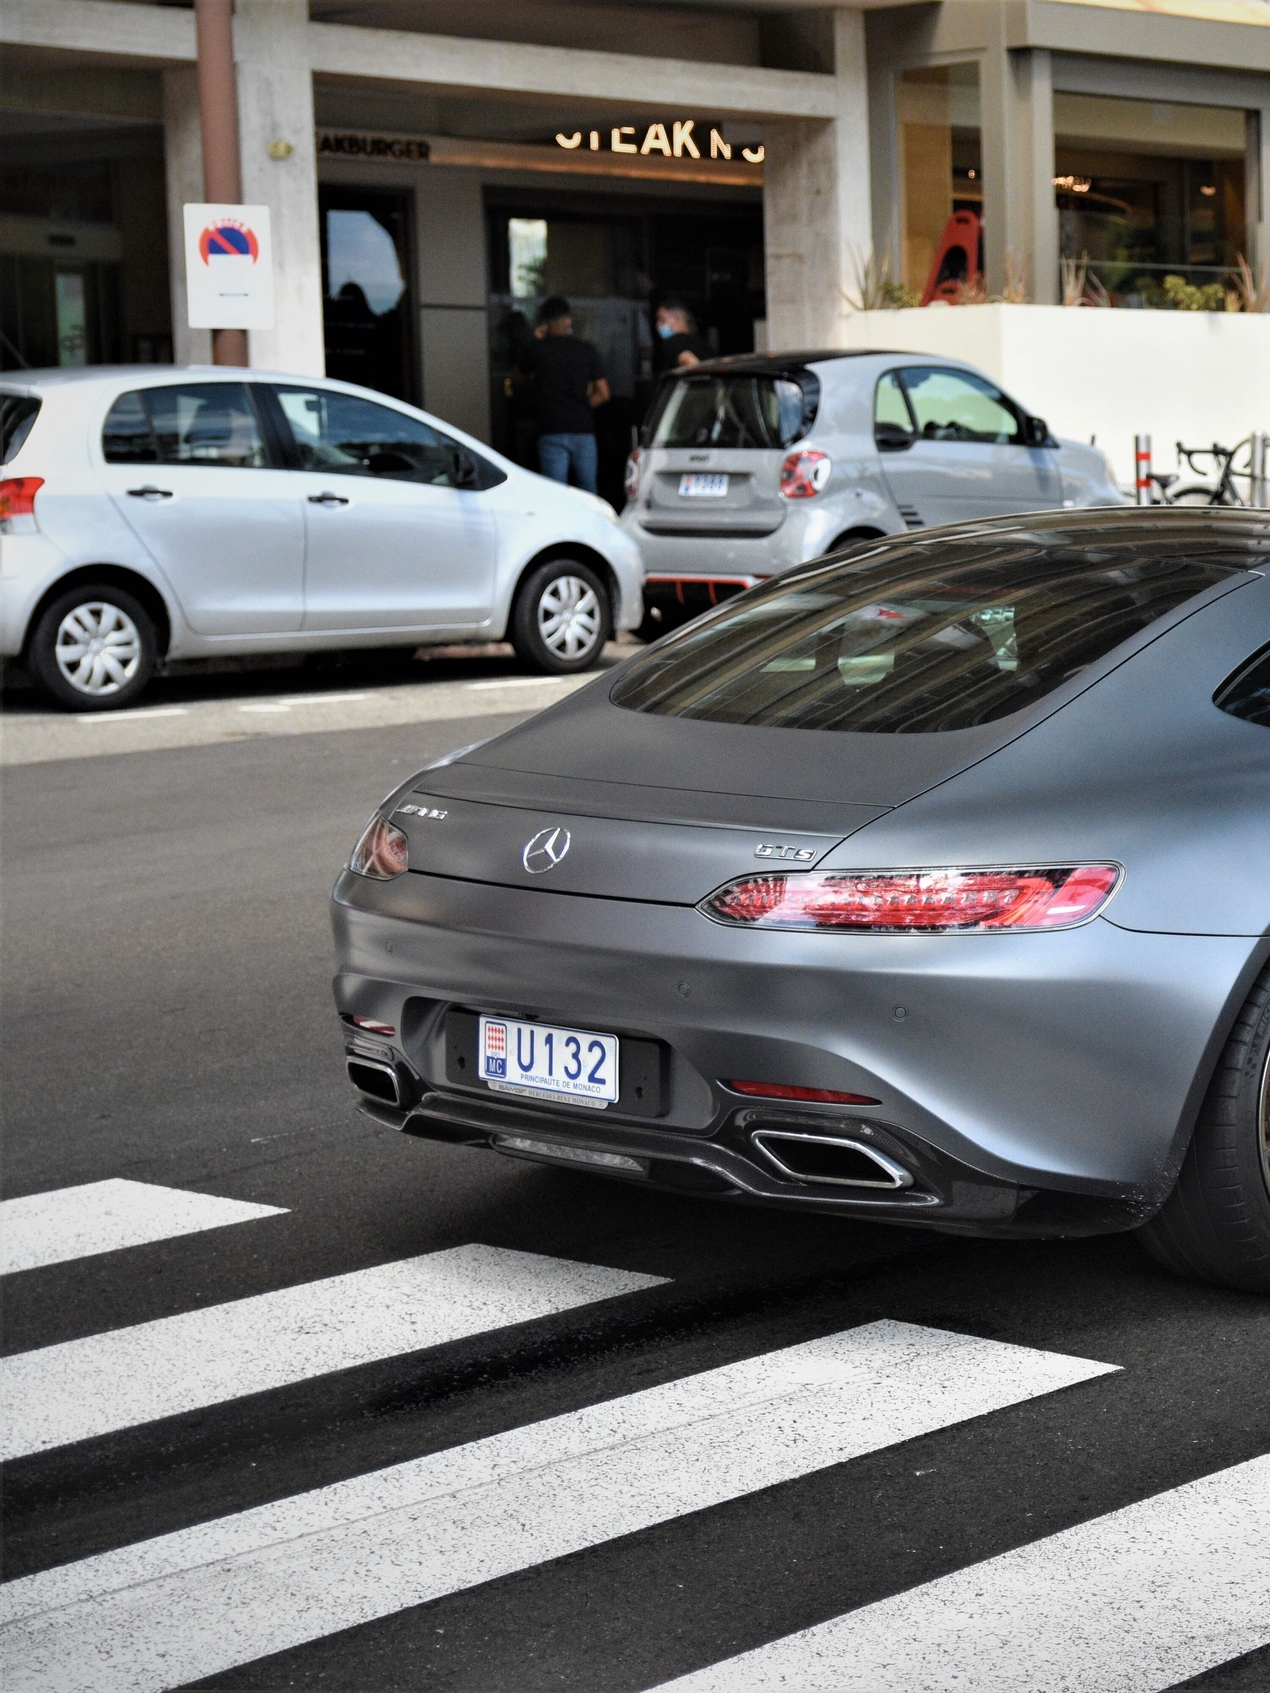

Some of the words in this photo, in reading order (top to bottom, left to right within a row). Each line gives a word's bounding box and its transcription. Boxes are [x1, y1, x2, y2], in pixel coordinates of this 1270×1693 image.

[316, 132, 431, 161] AKBURGER
[489, 1058, 503, 1074] MC
[517, 1027, 606, 1085] U132
[520, 1073, 560, 1087] PRINCIPAUTE
[562, 1080, 571, 1088] DE
[573, 1082, 601, 1094] MONACO
[572, 1098, 596, 1106] MONACO
